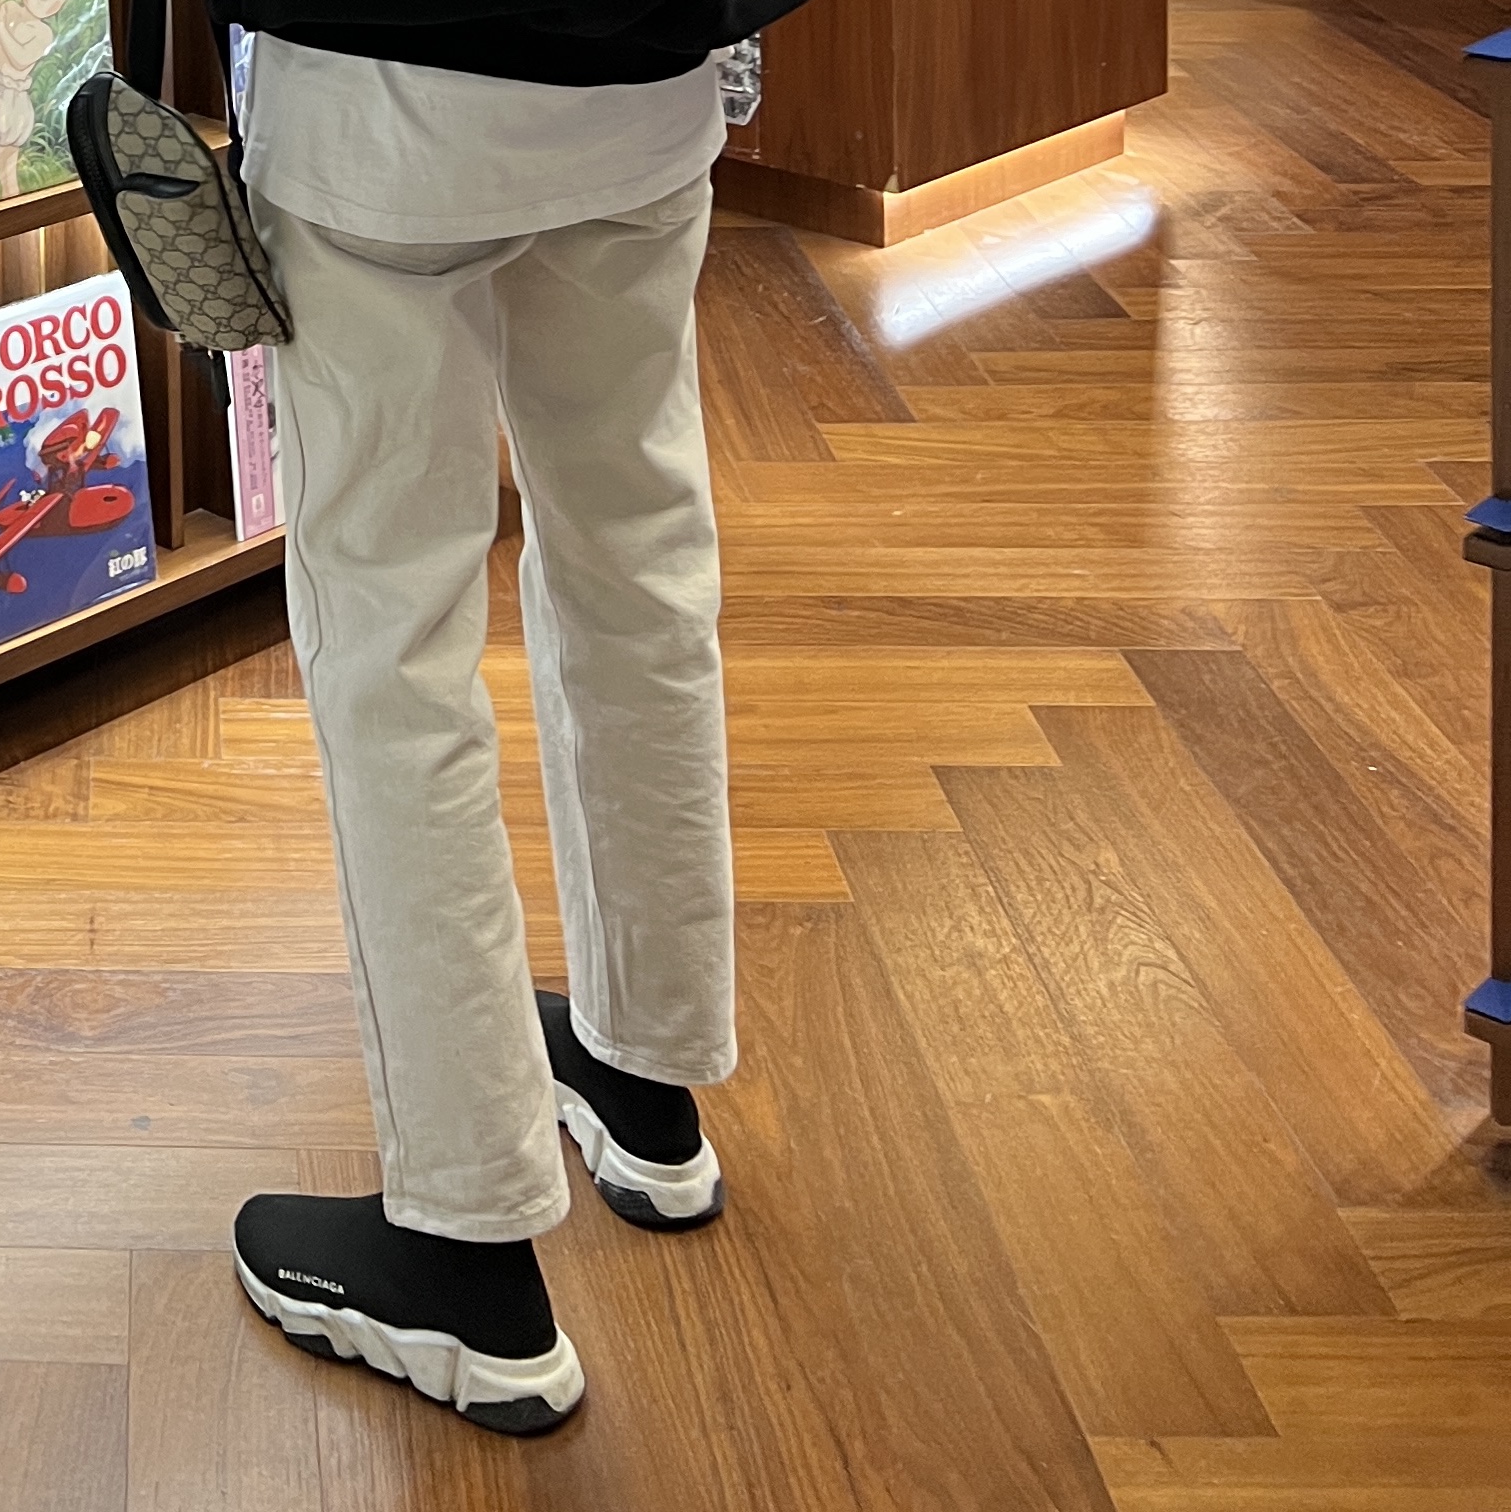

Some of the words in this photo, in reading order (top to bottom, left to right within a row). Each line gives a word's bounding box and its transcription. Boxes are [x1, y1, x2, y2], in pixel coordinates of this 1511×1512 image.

[107, 546, 148, 578] 紅の豚
[277, 1267, 346, 1296] BALENCIAGA
